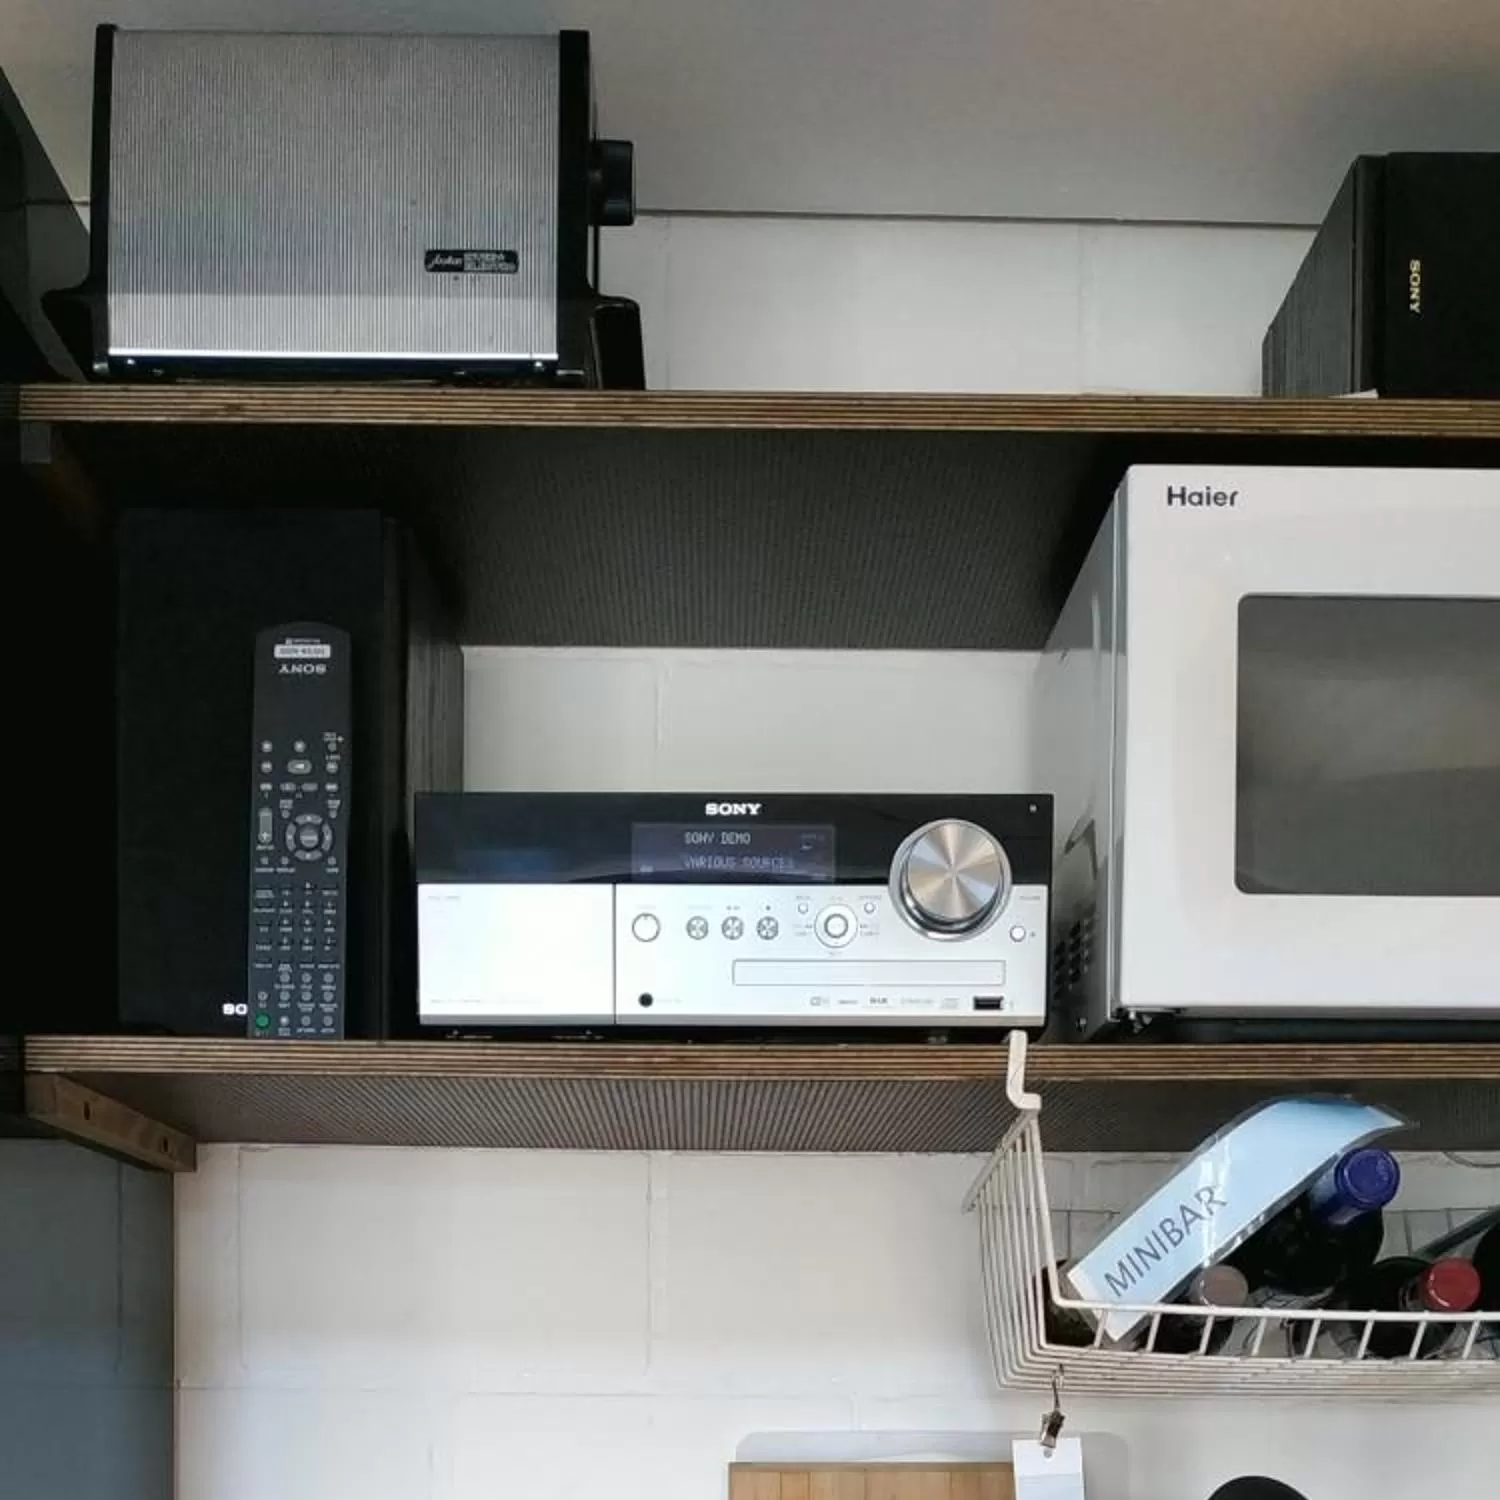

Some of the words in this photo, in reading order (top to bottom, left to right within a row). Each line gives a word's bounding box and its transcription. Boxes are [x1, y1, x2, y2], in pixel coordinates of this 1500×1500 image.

[1409, 259, 1421, 314] SONY
[1167, 485, 1239, 507] Haier
[278, 663, 327, 675] SONY
[704, 802, 762, 816] SONY
[719, 831, 751, 845] DEMO
[222, 1003, 249, 1016] SO
[1103, 1186, 1228, 1297] MINIBAR
